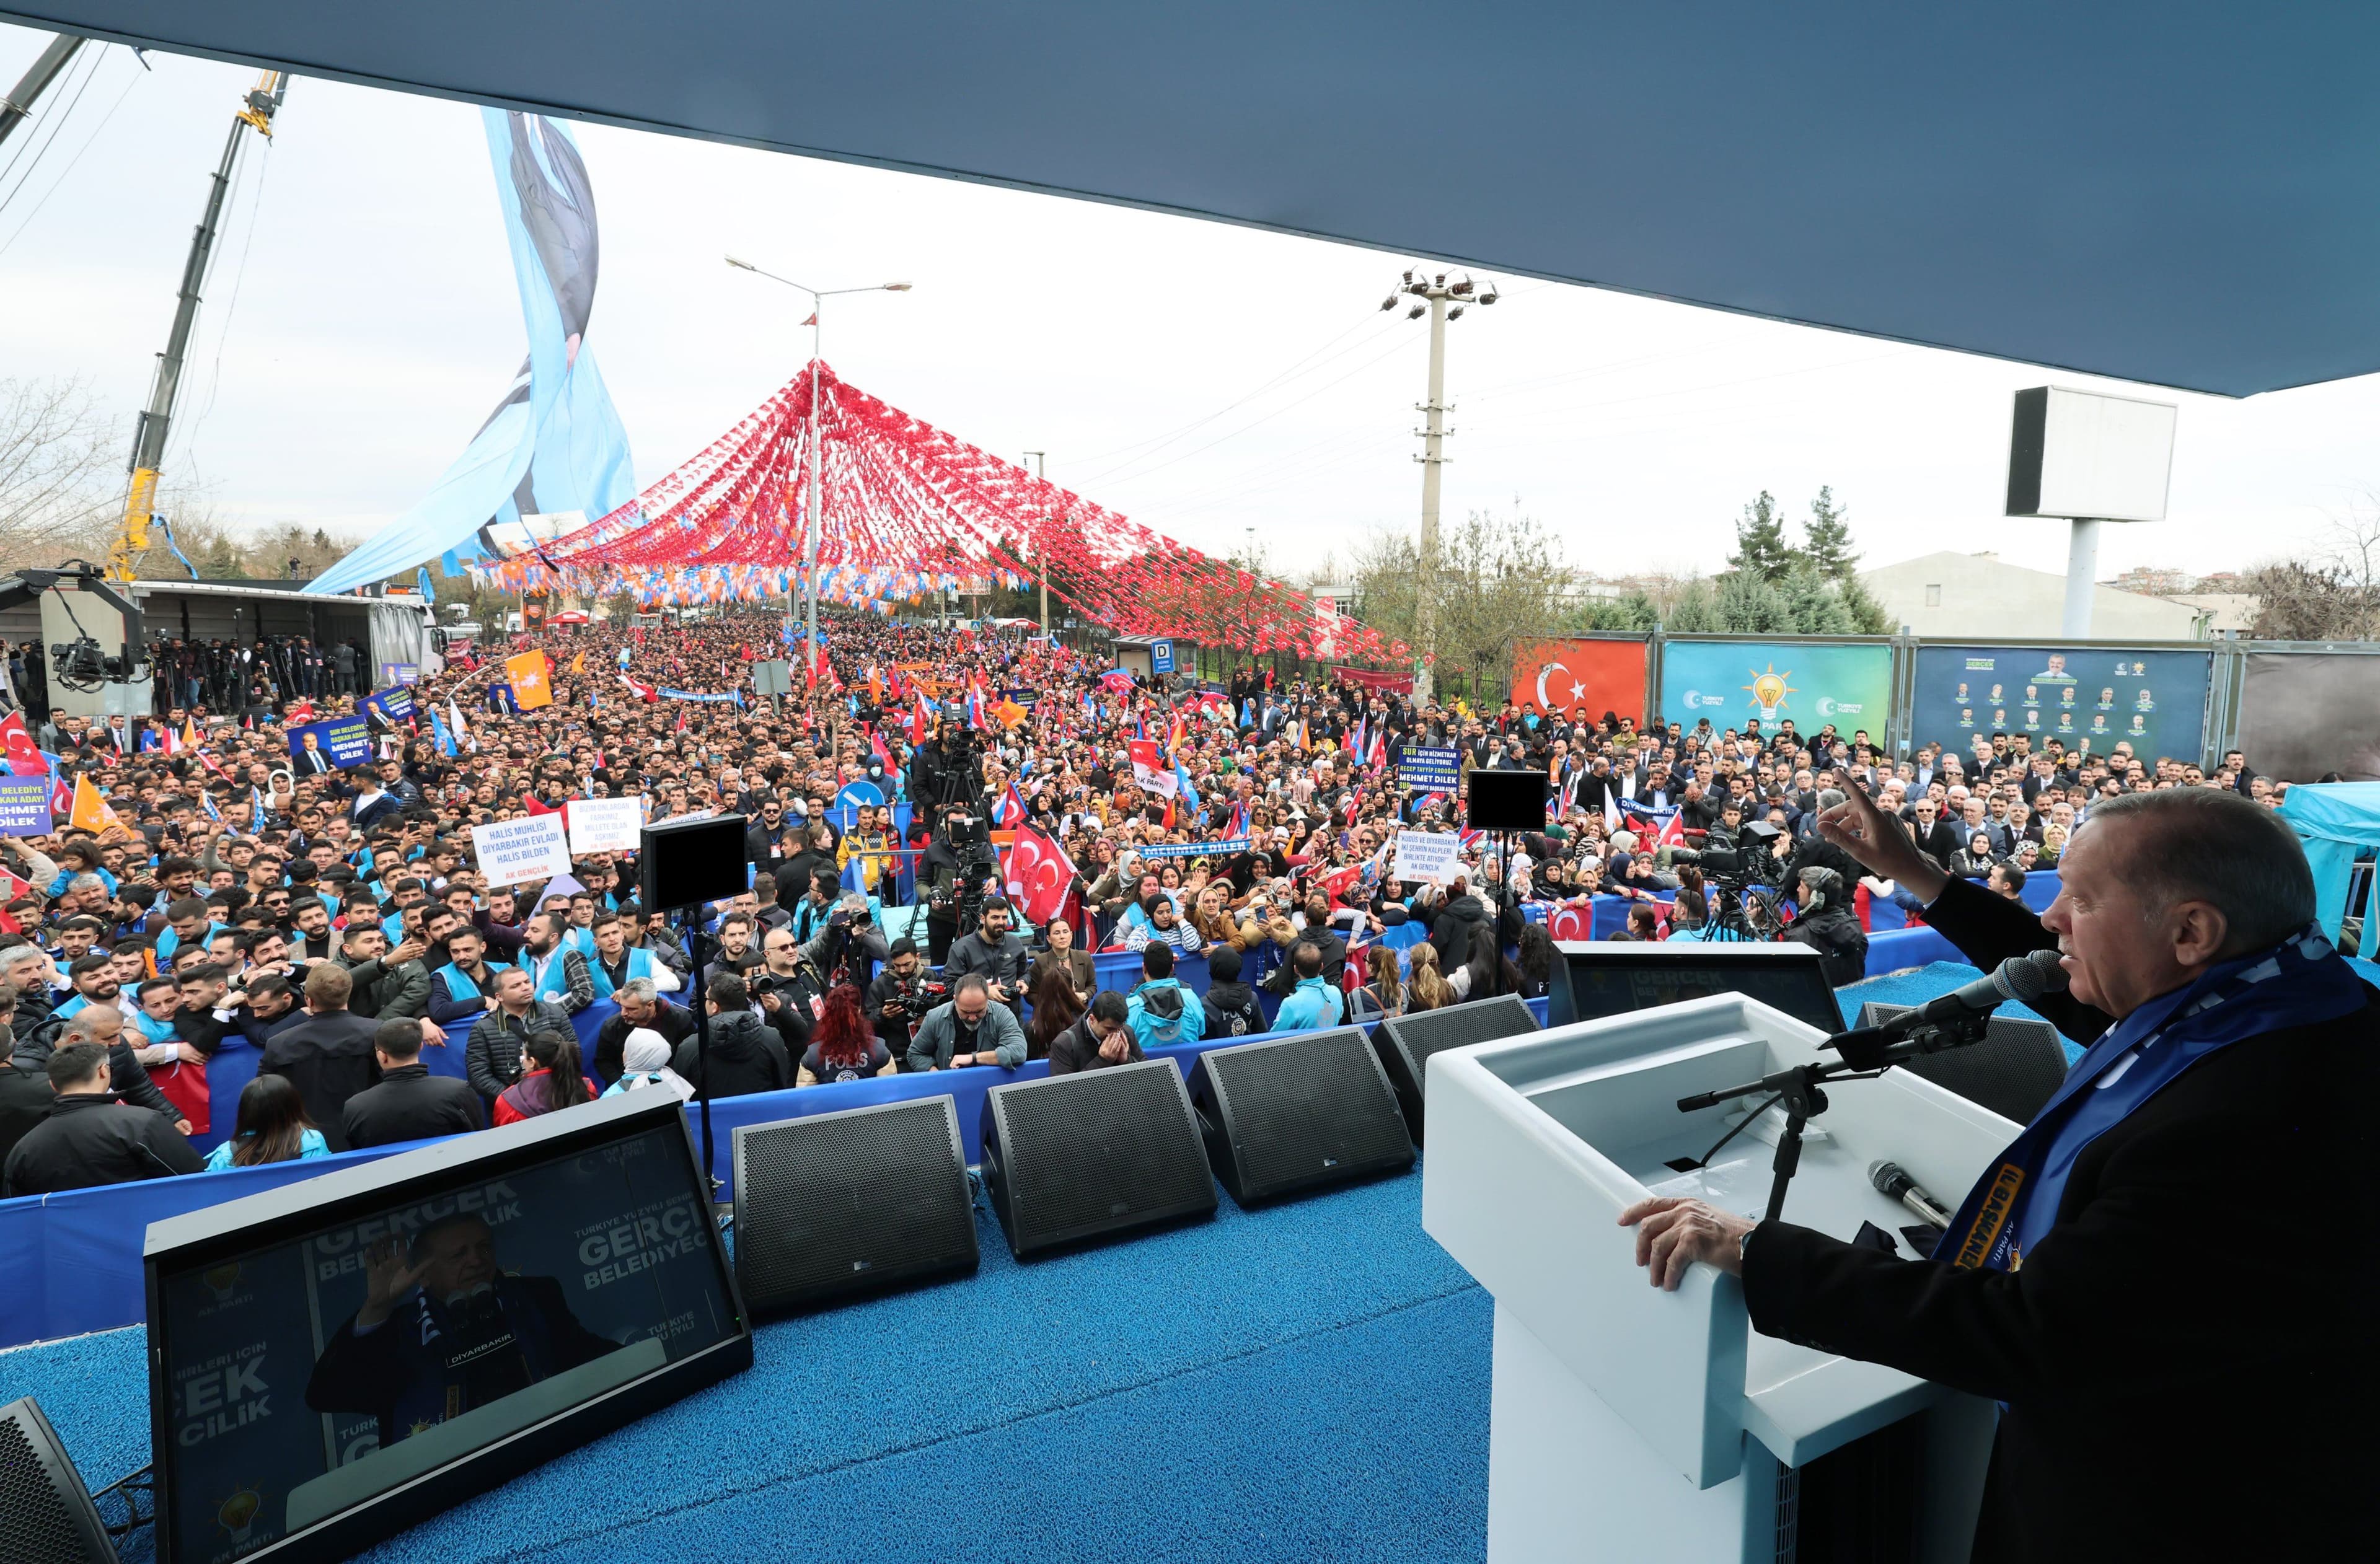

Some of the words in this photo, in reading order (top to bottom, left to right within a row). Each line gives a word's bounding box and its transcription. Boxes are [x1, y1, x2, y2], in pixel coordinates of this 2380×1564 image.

[1158, 646, 1166, 657] D
[1762, 722, 1783, 731] PAR
[331, 739, 369, 752] MEHMET
[339, 749, 364, 760] DİLEK
[1403, 747, 1417, 756] SUR
[1426, 758, 1453, 766] GELİYORUZ
[1399, 773, 1434, 783] MEHMET
[1434, 776, 1458, 784] DİLEK
[1, 786, 43, 794] BELEDİYE
[20, 795, 45, 804] ADAYI
[490, 828, 513, 840] HALİS
[514, 820, 547, 835] MUHLİSİ
[482, 837, 530, 854] DİYARBAKIR
[532, 832, 559, 845] EVLADI
[1145, 845, 1204, 855] MEHMET
[1208, 841, 1246, 851] DİLEK
[496, 851, 521, 864] HALİS
[522, 846, 550, 860] BİLDEN
[1404, 853, 1426, 861] BİRLİKTE
[518, 865, 549, 877] GENÇLİK
[2006, 1220, 2016, 1237] AK
[1993, 1236, 2009, 1264] PARTİ
